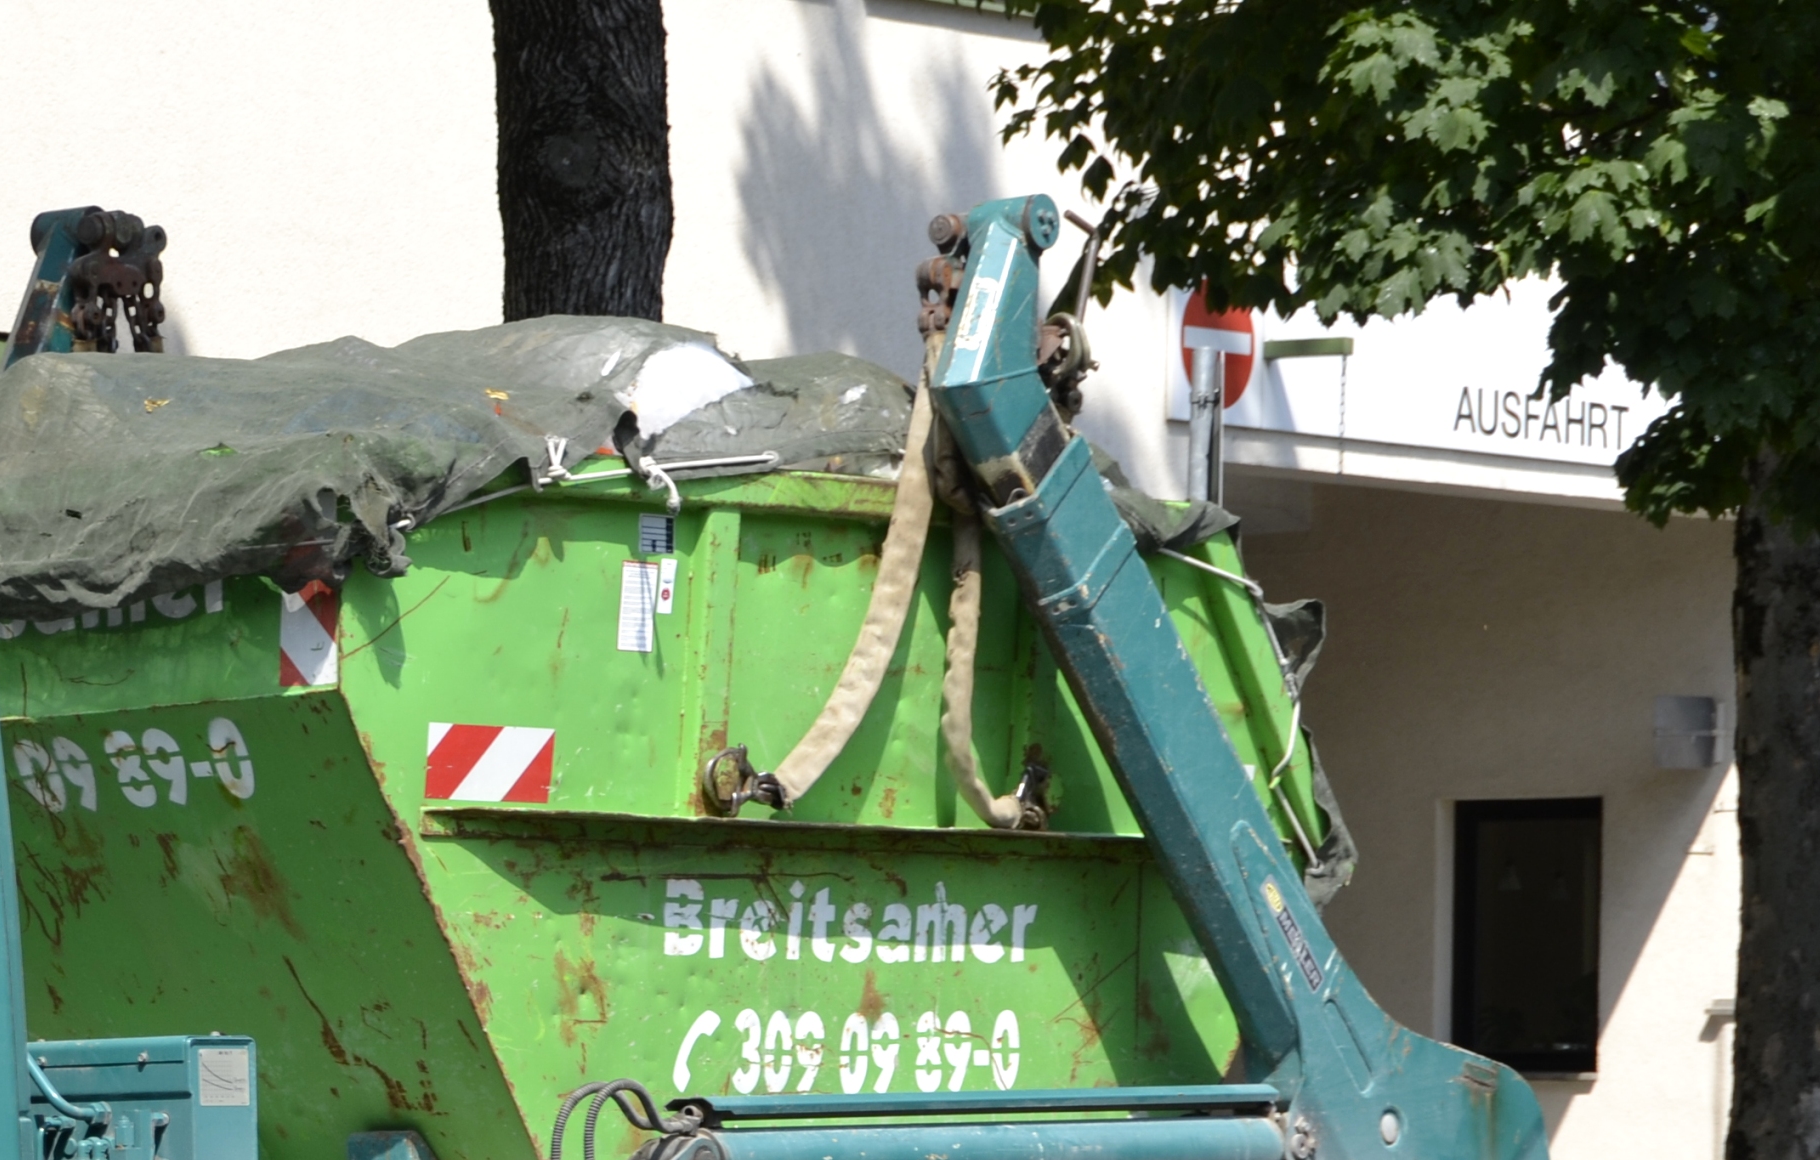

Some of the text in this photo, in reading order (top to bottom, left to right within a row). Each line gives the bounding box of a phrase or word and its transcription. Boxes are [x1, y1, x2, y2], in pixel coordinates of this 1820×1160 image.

[1453, 386, 1629, 450] AUSFAHRT
[13, 716, 256, 813] 09 89-0
[663, 878, 1038, 964] Breitsamer
[731, 1008, 1020, 1094] 309 09 89-0
